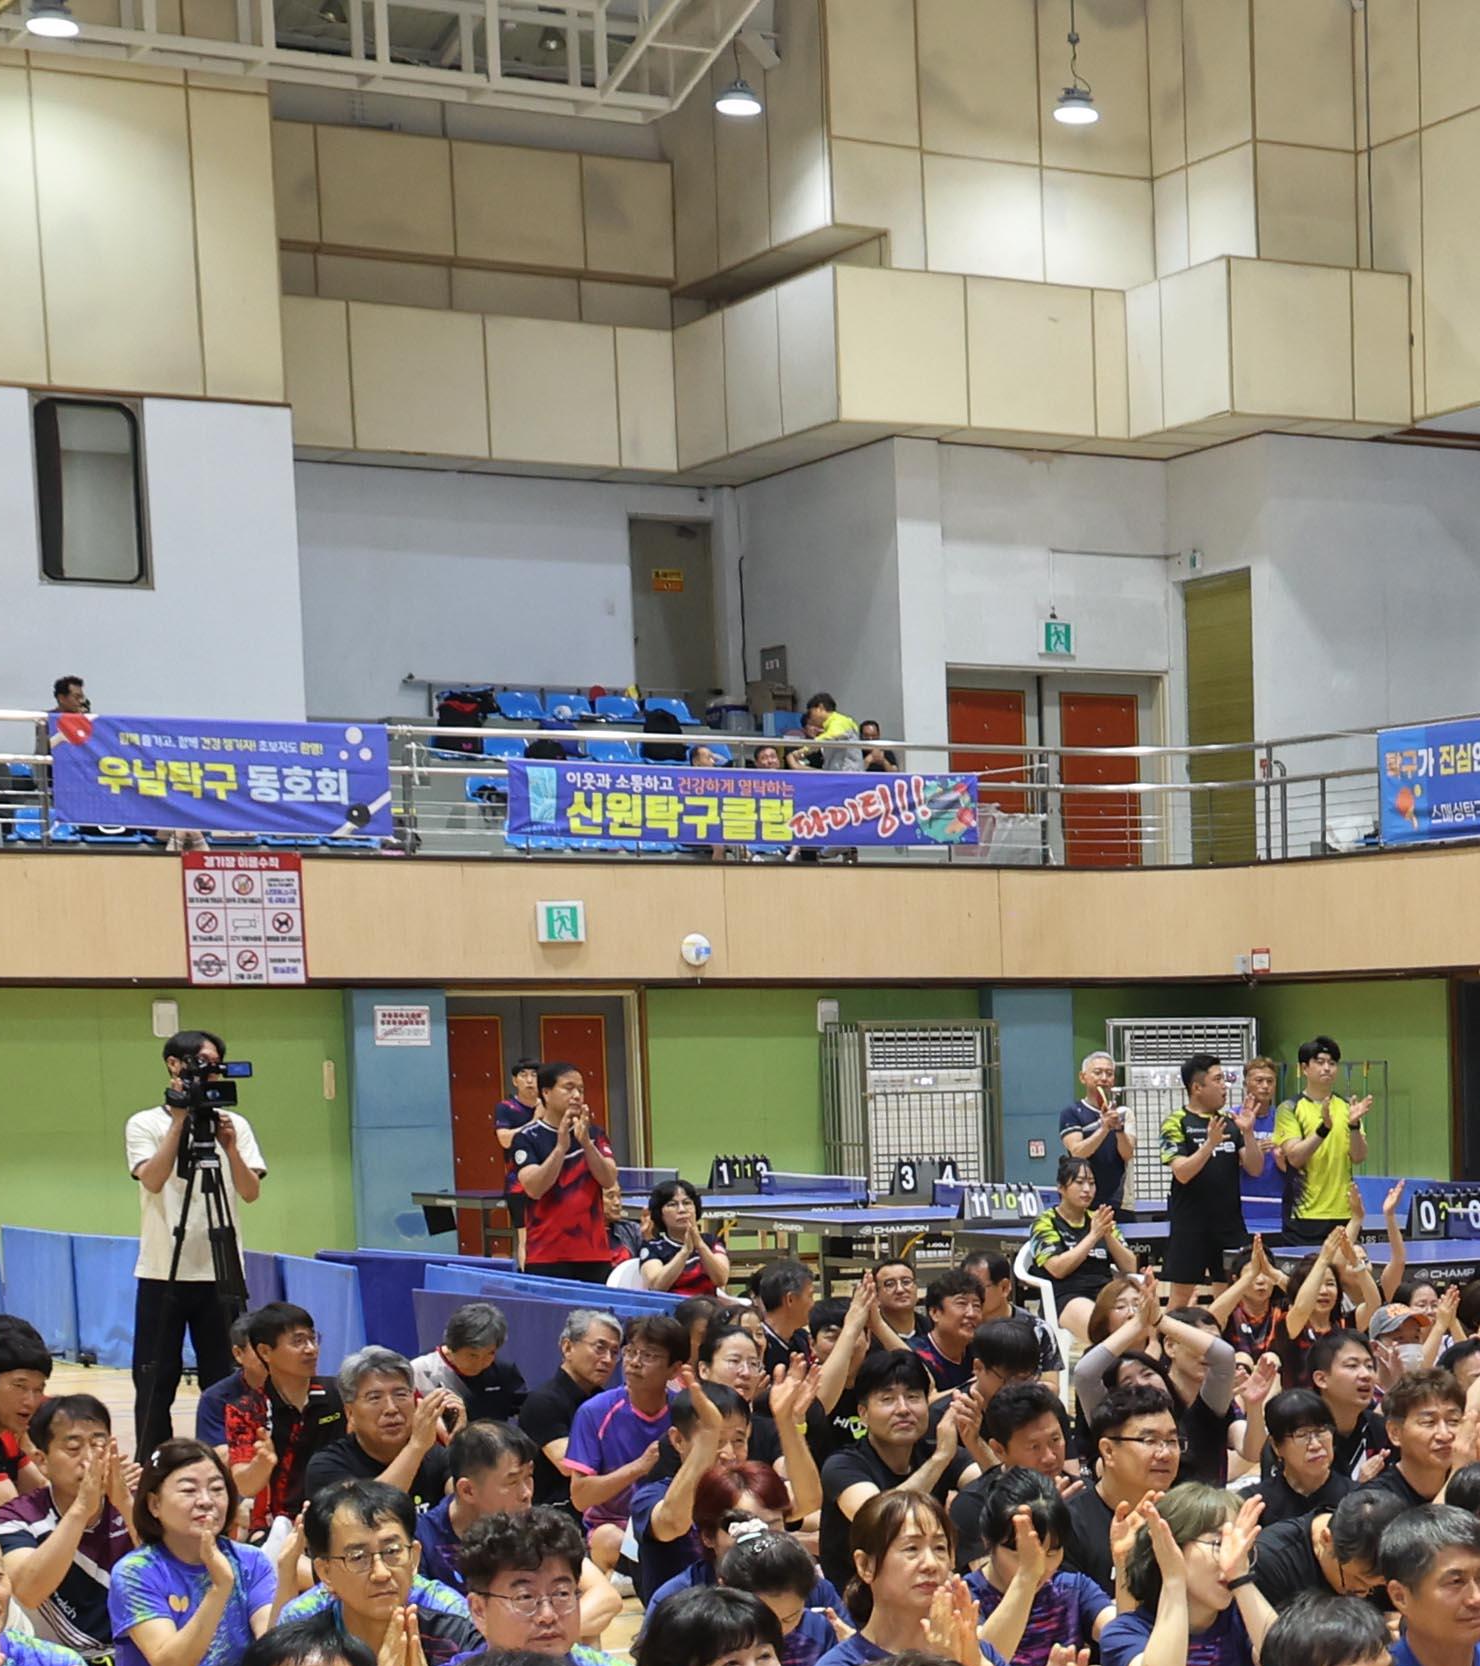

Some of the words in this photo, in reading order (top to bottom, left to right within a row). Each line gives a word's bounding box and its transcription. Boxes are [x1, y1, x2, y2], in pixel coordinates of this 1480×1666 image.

[1384, 748, 1435, 779] 탁구가
[97, 756, 238, 800] 우남탁구
[248, 763, 349, 806] 동호회
[566, 771, 613, 790] 이웃과
[615, 774, 674, 792] 소통하고
[677, 777, 735, 794] 건강하게
[566, 793, 793, 841] 신원탁구클럽
[900, 1167, 915, 1192] 3
[872, 1223, 930, 1235] CHAMPION
[1429, 1267, 1476, 1280] CHAMP
